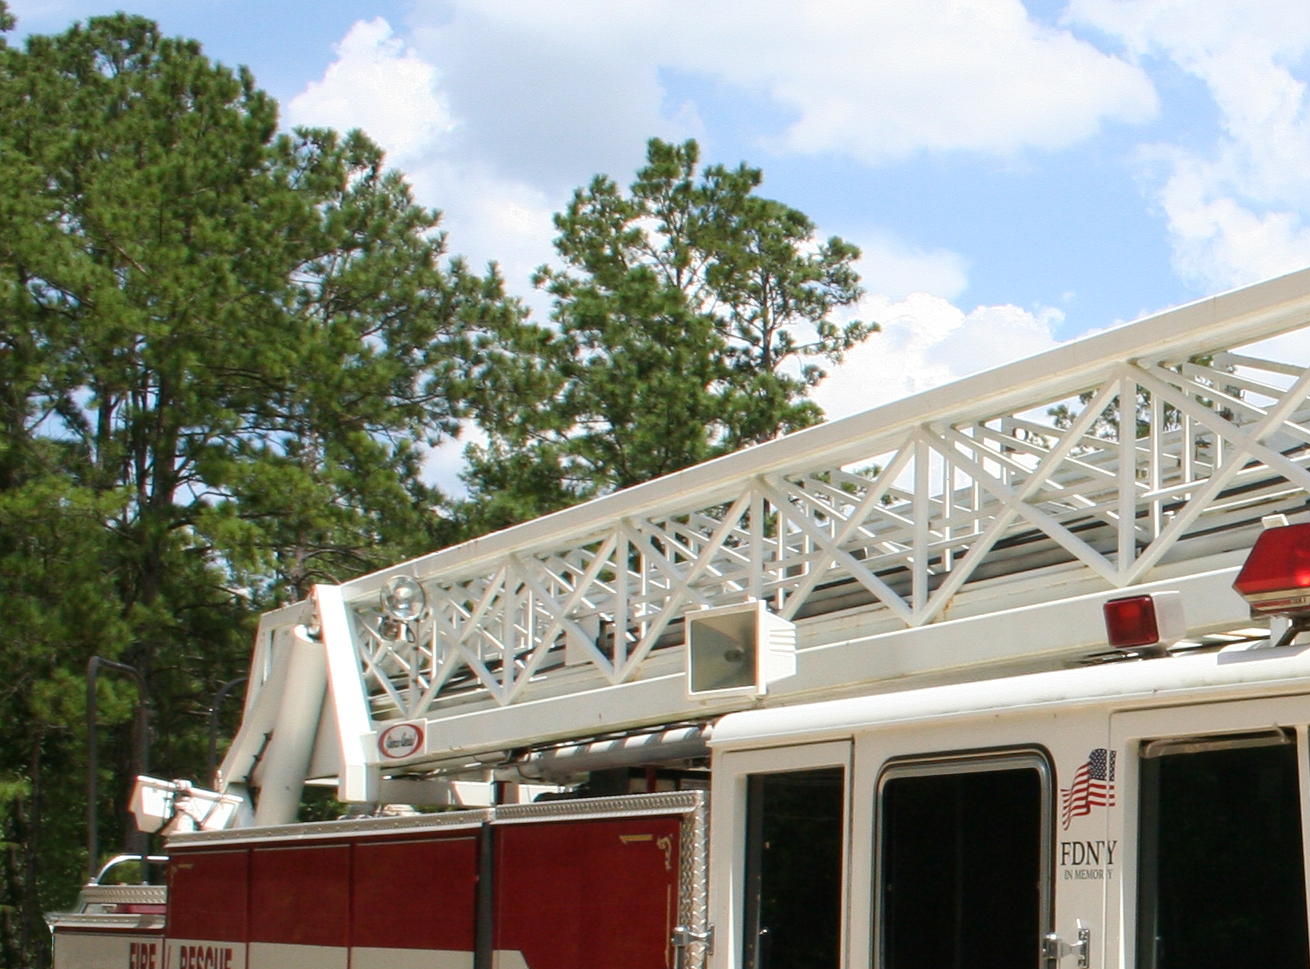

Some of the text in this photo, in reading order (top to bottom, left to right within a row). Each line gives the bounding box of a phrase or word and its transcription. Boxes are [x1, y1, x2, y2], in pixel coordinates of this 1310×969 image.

[1060, 840, 1117, 866] FDNY
[1064, 868, 1114, 880] IN MEMORY
